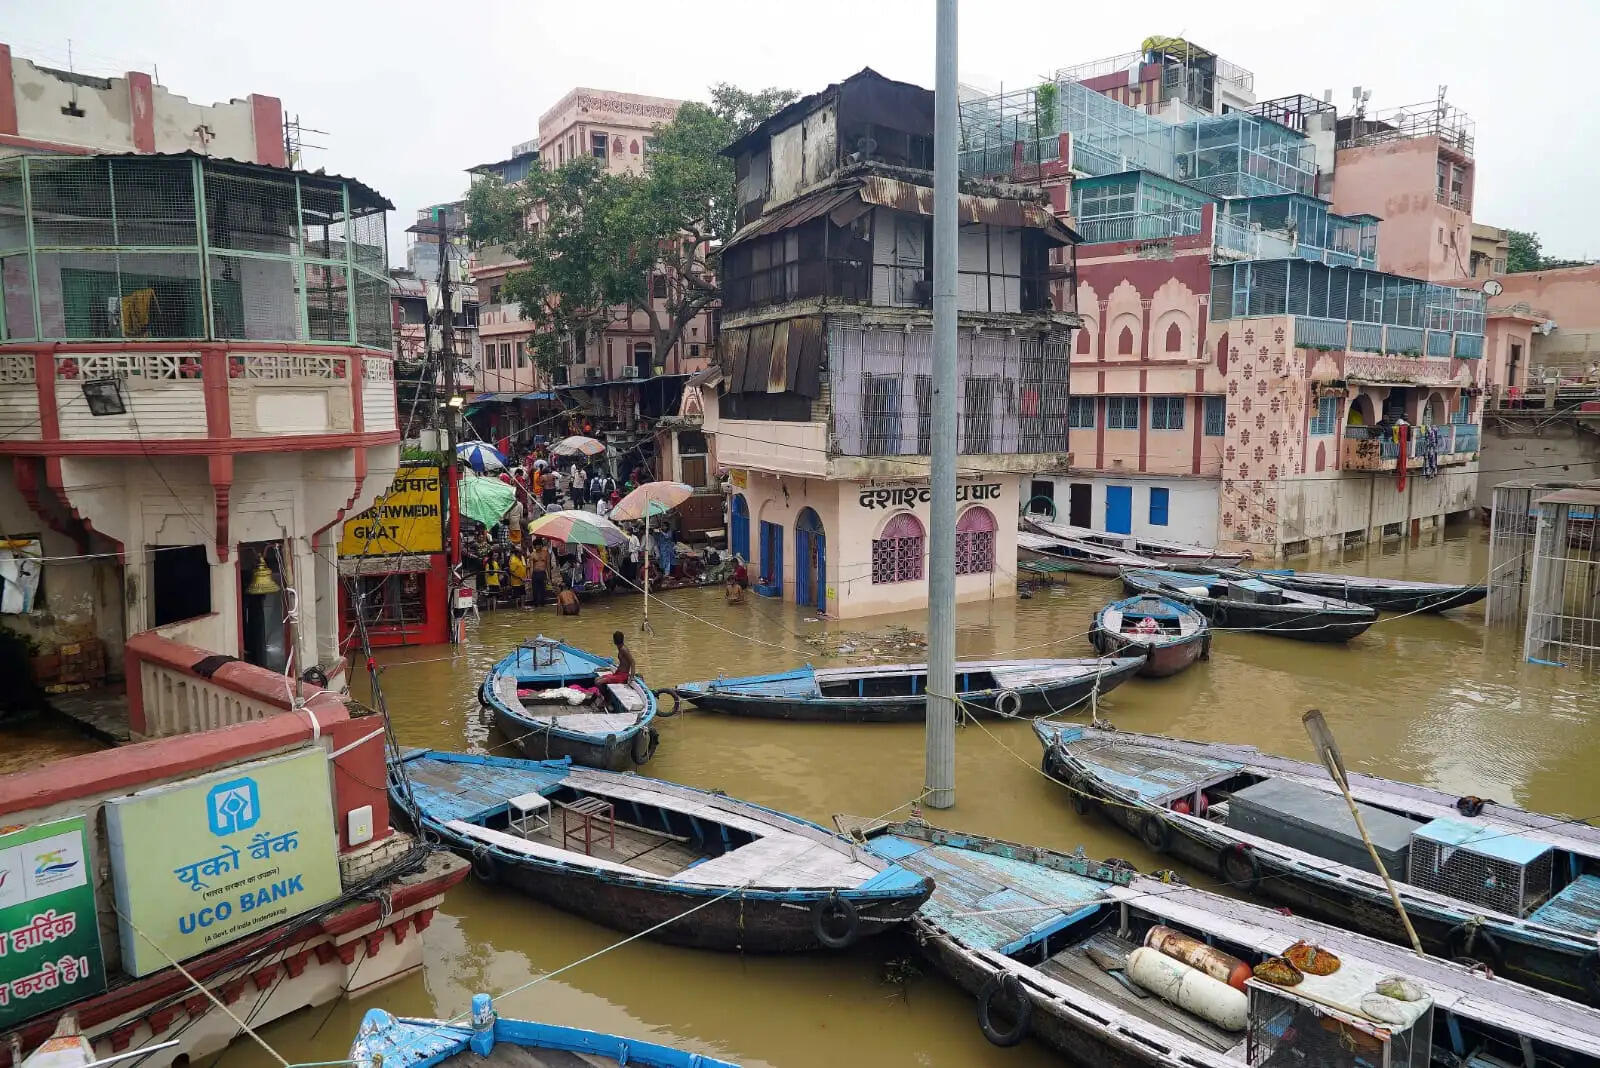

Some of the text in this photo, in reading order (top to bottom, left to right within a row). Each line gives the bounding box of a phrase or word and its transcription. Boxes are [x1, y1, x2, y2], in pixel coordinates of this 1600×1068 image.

[970, 482, 1003, 500] घाट
[173, 831, 299, 891] यूको बैंक
[178, 874, 304, 935] UCO BANK
[11, 910, 75, 951] हार्दिक
[237, 920, 251, 930] India
[12, 963, 58, 997] करते
